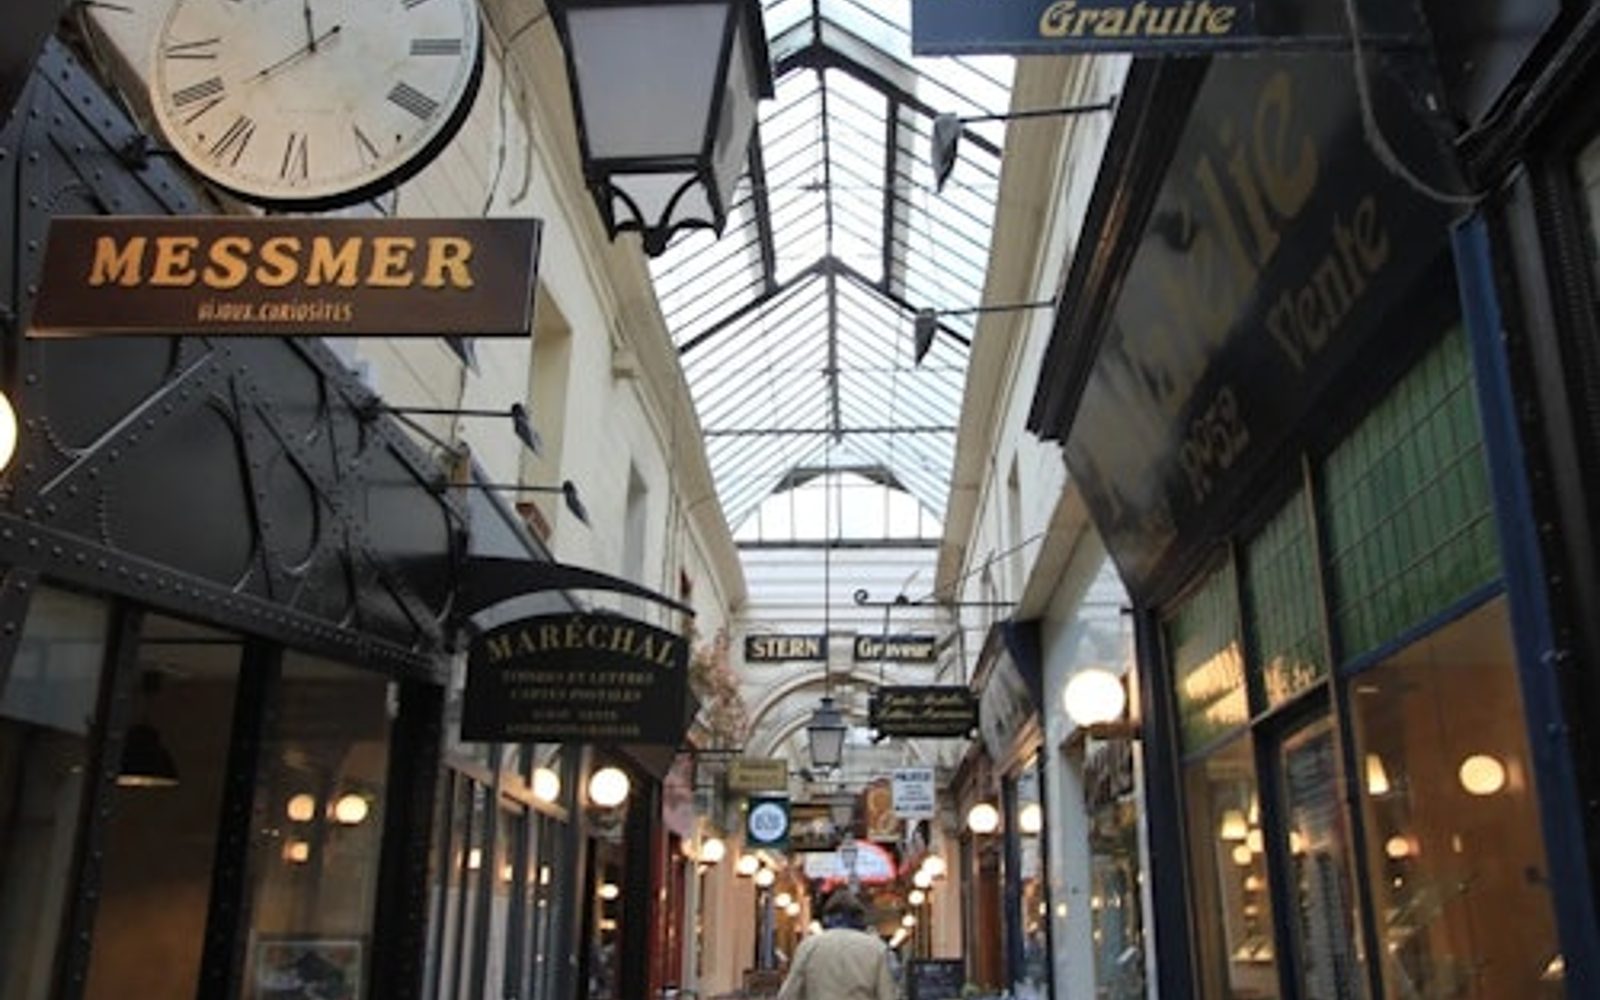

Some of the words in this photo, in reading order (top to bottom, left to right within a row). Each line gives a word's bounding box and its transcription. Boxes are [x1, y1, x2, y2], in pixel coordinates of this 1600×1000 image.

[1038, 0, 1237, 37] Gratuite
[87, 235, 475, 289] MESSMER
[1265, 195, 1390, 369] Vente
[485, 615, 677, 669] MARÉCHAL
[751, 637, 821, 659] STERN
[857, 637, 934, 659] Graveur
